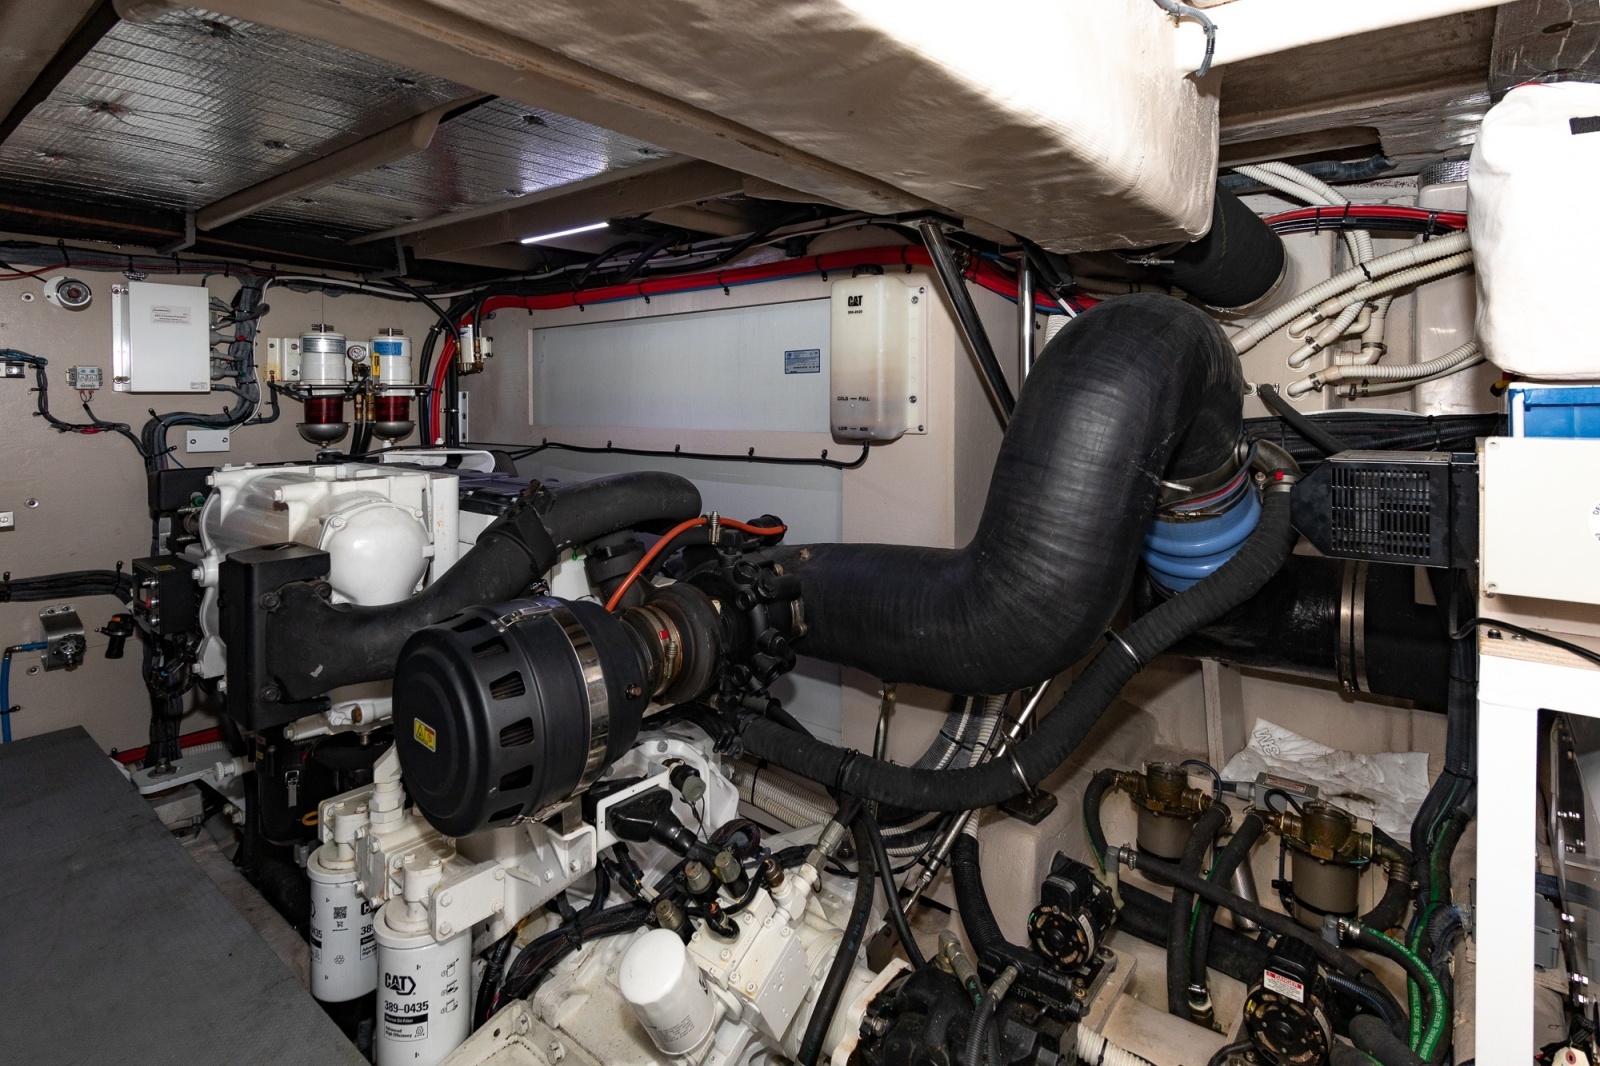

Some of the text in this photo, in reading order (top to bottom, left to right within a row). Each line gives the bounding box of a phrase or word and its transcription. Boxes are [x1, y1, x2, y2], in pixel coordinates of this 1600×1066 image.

[848, 295, 863, 307] CAT
[1253, 728, 1280, 757] 3M
[385, 972, 410, 992] CAT
[384, 999, 429, 1014] 389-0435
